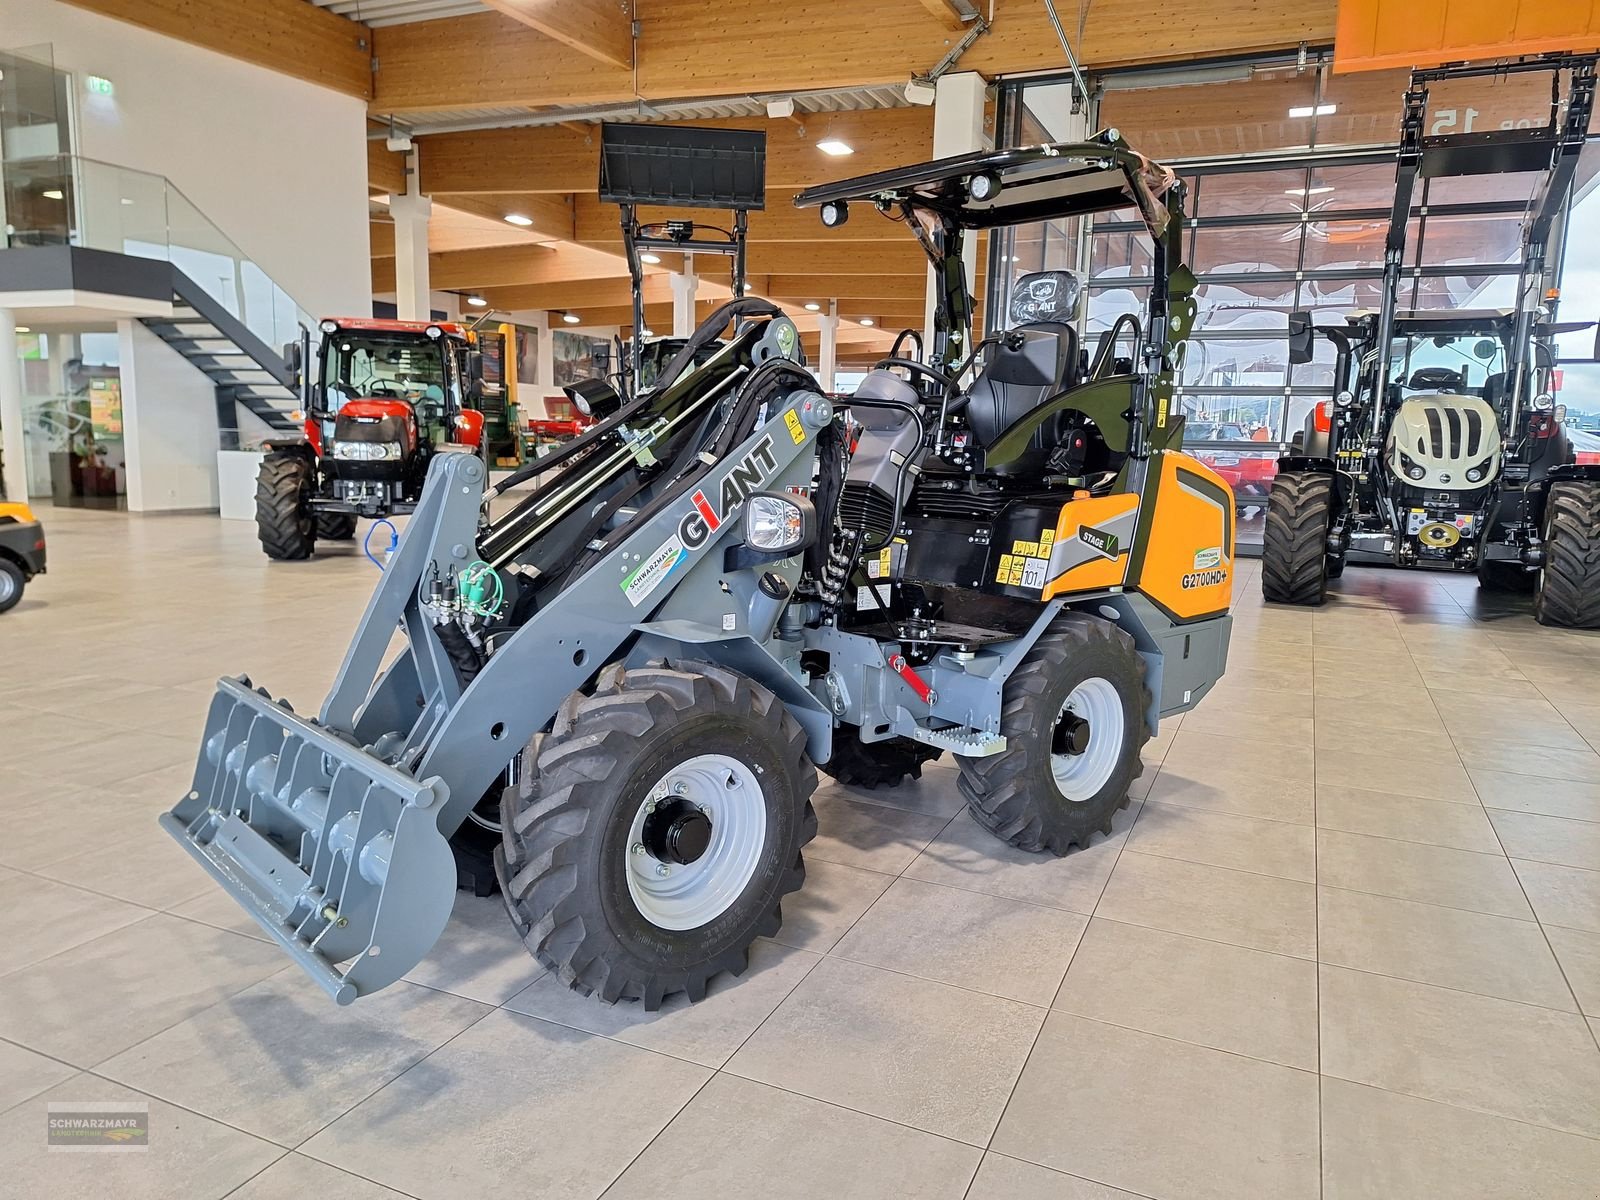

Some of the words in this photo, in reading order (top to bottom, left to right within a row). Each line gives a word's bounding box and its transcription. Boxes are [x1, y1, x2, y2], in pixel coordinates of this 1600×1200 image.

[1083, 532, 1104, 548] STAGE
[1106, 535, 1117, 551] V
[629, 547, 673, 590] SCHWARZMAYR
[1024, 570, 1038, 586] 101
[1182, 570, 1226, 589] G2700HD+
